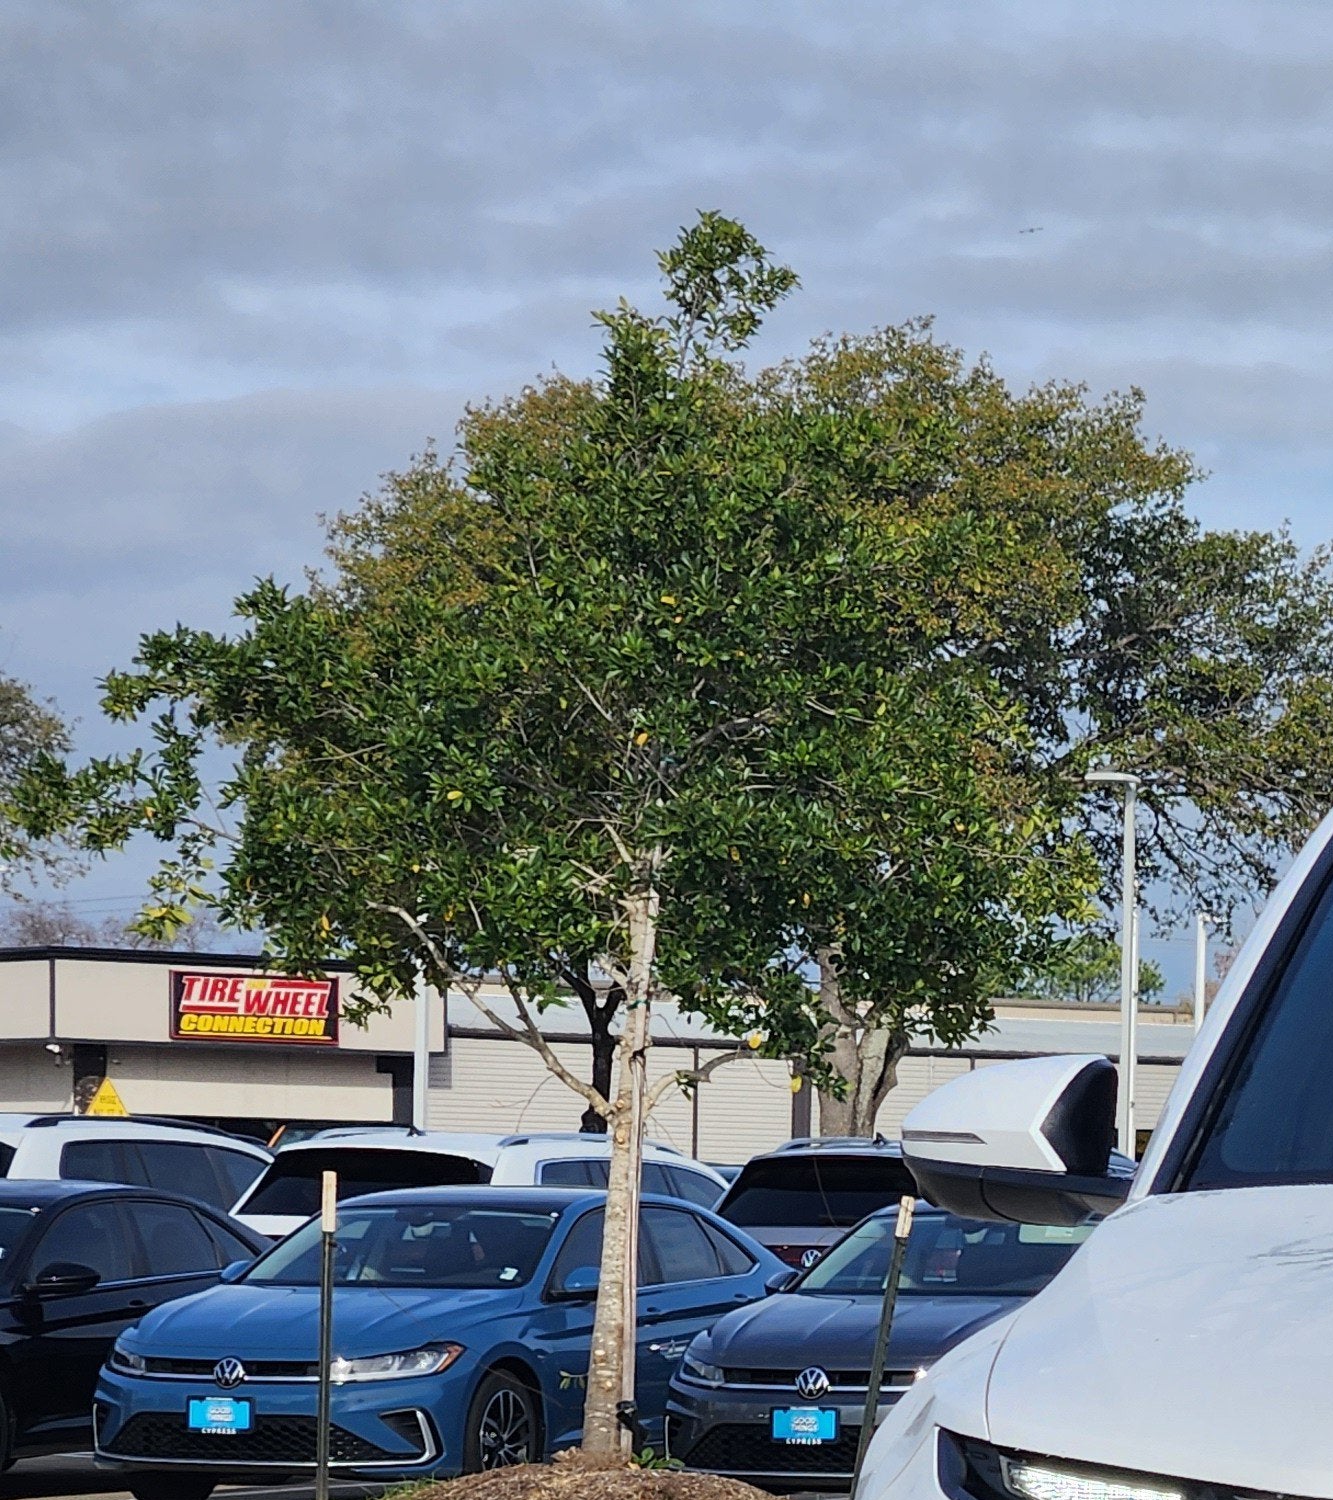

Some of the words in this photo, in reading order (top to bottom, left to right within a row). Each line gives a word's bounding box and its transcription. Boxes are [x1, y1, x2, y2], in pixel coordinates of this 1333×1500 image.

[182, 977, 244, 1003] TIRE
[244, 989, 329, 1017] WHEEL
[180, 1013, 326, 1036] CONNECTION
